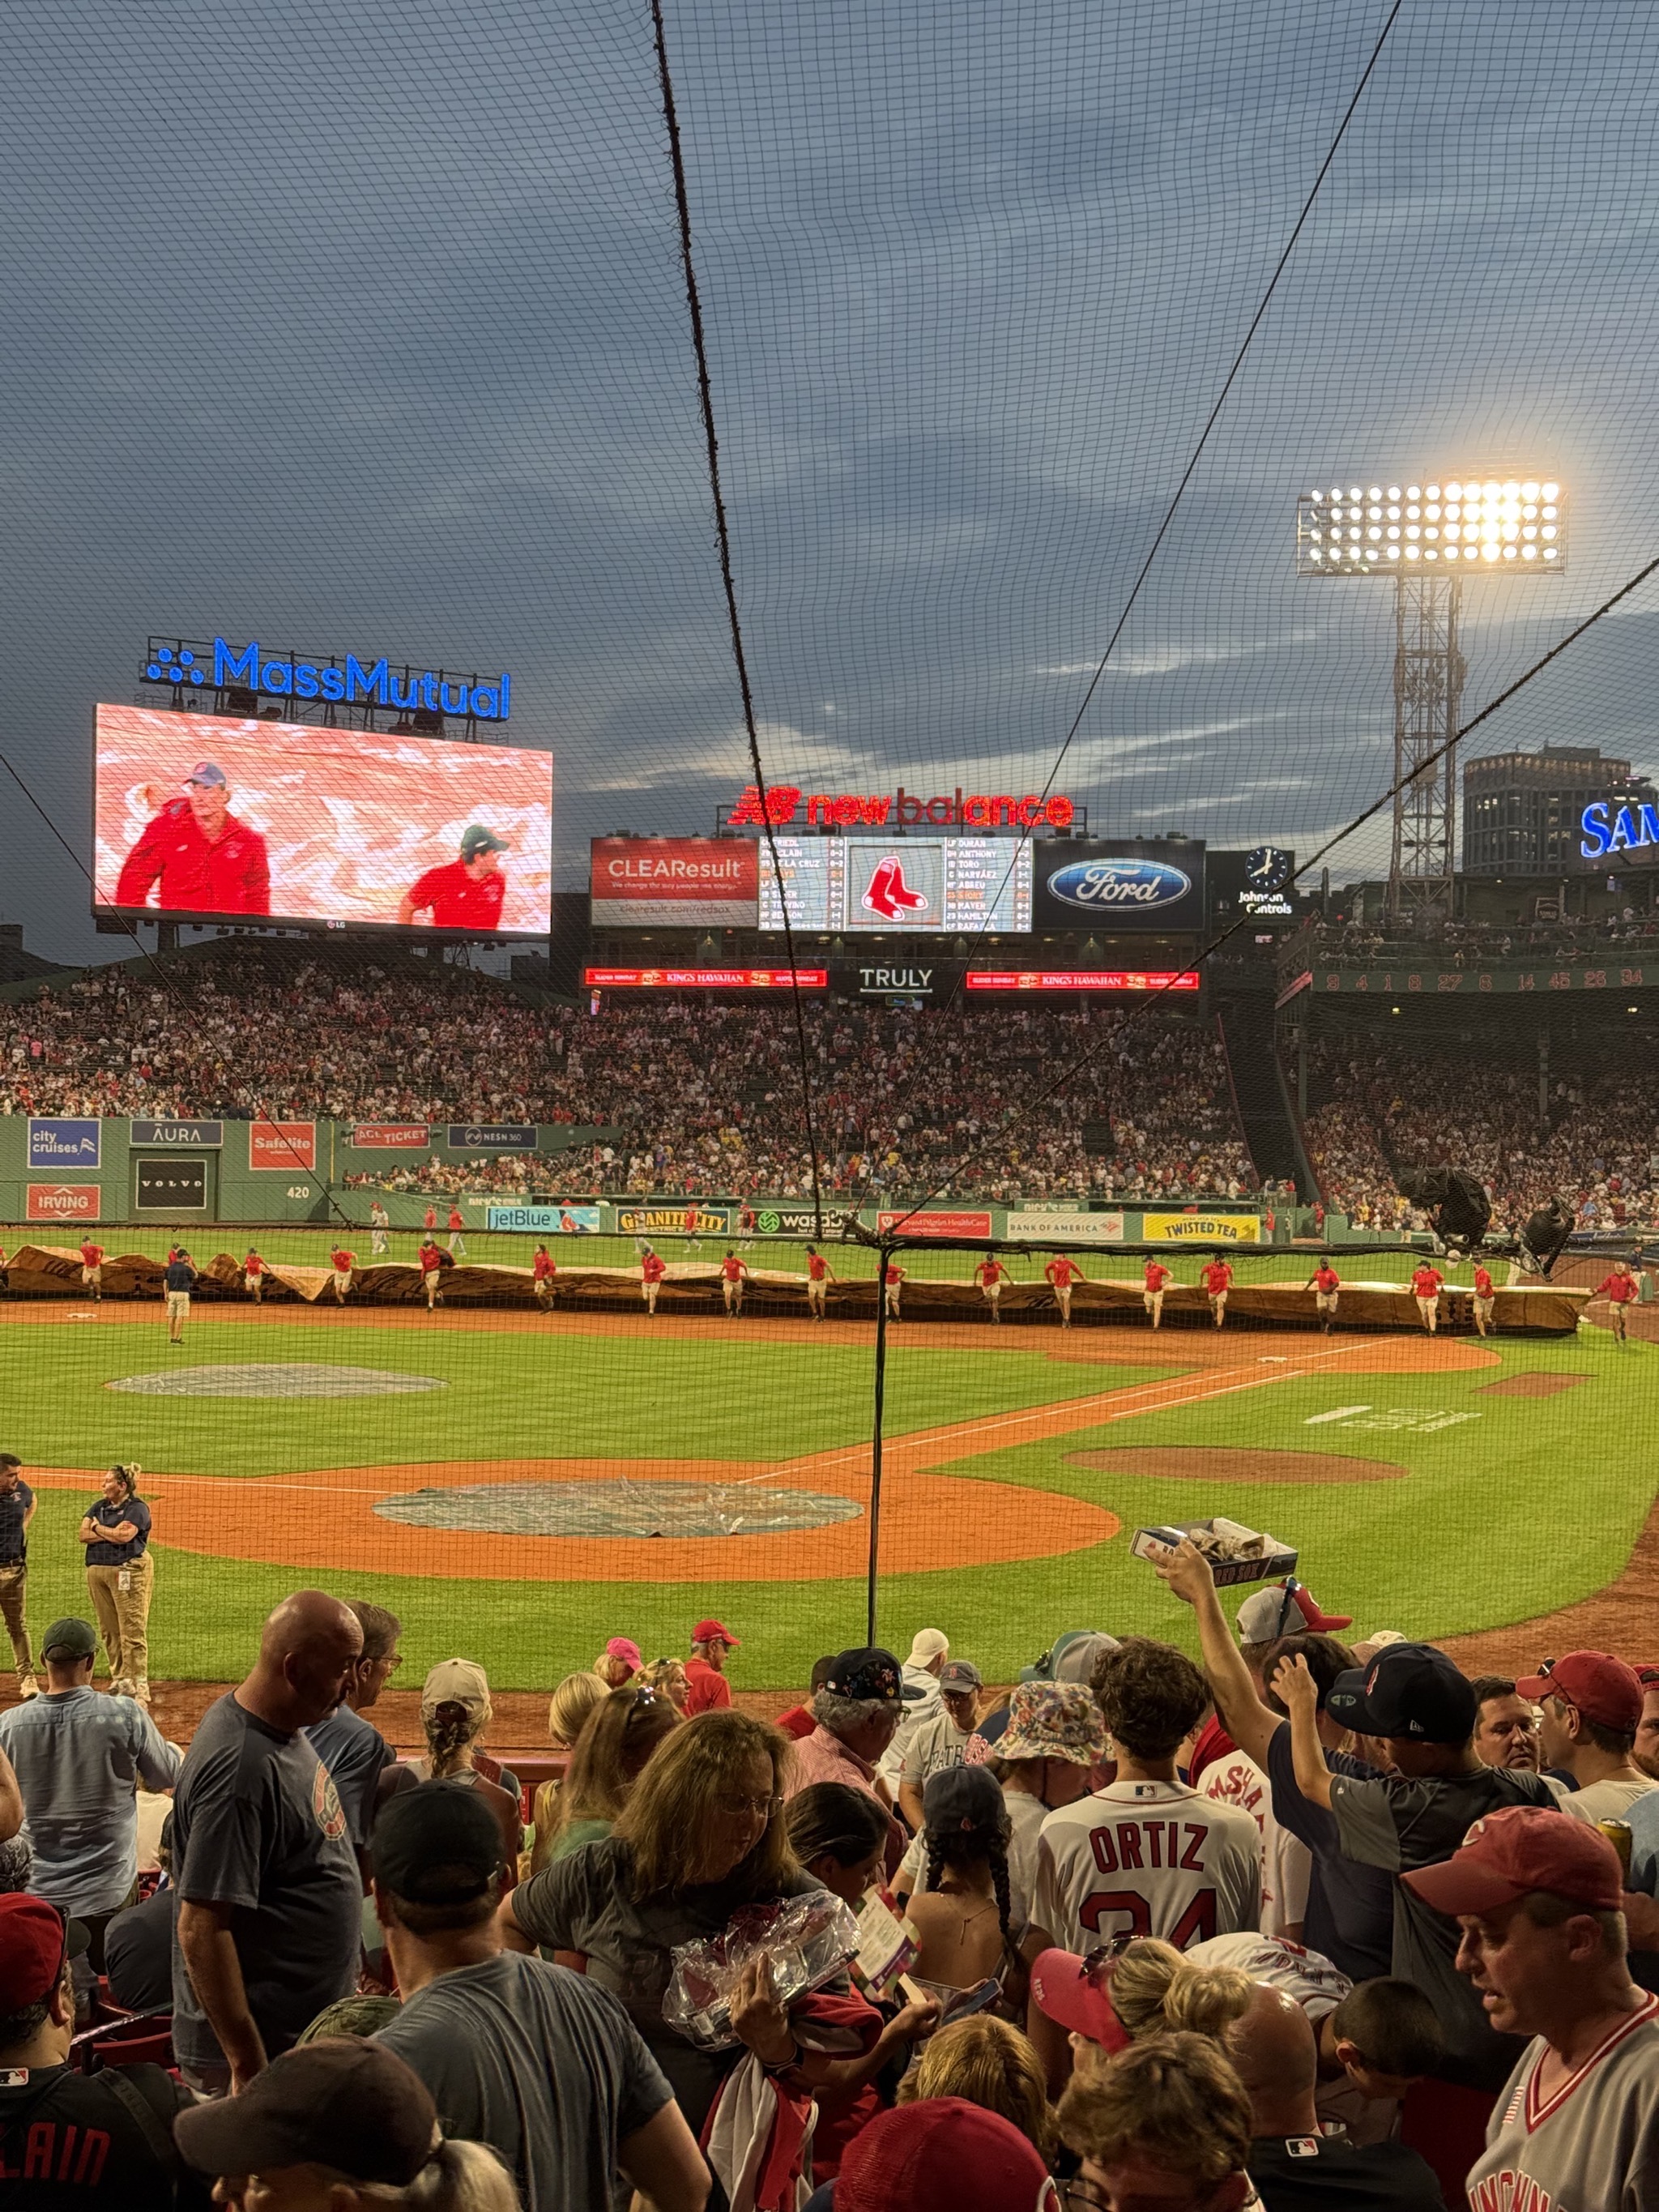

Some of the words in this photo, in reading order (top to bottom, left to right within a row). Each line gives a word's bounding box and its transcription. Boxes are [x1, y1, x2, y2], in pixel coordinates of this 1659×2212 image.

[214, 637, 510, 720] MassMutual
[808, 795, 892, 826] new
[898, 788, 1075, 826] balance
[958, 850, 997, 858] ANTHONY
[609, 859, 740, 878] CLEAResult
[958, 860, 979, 869] TORO
[1076, 866, 1162, 901] Ford
[1238, 890, 1283, 903] Johnson
[621, 903, 730, 915] clearesult.com/redsox
[1246, 902, 1292, 914] Controls
[335, 920, 346, 929] LG
[697, 974, 744, 983] HAWAIIAN
[859, 968, 932, 987] TRULY
[1043, 976, 1073, 985] KING'S
[1074, 976, 1121, 986] HAWAIIAN
[1355, 975, 1369, 992] 4
[1384, 975, 1392, 992] 1
[1438, 975, 1463, 992] 27
[1518, 974, 1535, 991] 14
[1621, 968, 1644, 986] 34
[32, 1129, 56, 1143] city
[384, 1129, 427, 1144] TICKET
[484, 1134, 507, 1142] NESN
[32, 1142, 79, 1153] cruises
[254, 1137, 312, 1150] Safelite
[141, 1180, 203, 1188] VOLVO
[287, 1186, 309, 1199] 420
[38, 1196, 88, 1210] IRVING
[494, 1209, 551, 1228] jetBlue
[1011, 1223, 1036, 1232] BANK
[1038, 1223, 1051, 1232] OF
[1054, 1224, 1098, 1233] AMERICA
[1165, 1222, 1216, 1238] TWISTED
[1218, 1223, 1238, 1239] TEA
[1215, 1566, 1236, 1585] RED
[1238, 1563, 1260, 1582] SOX
[1088, 1821, 1209, 1875] ORTIZ
